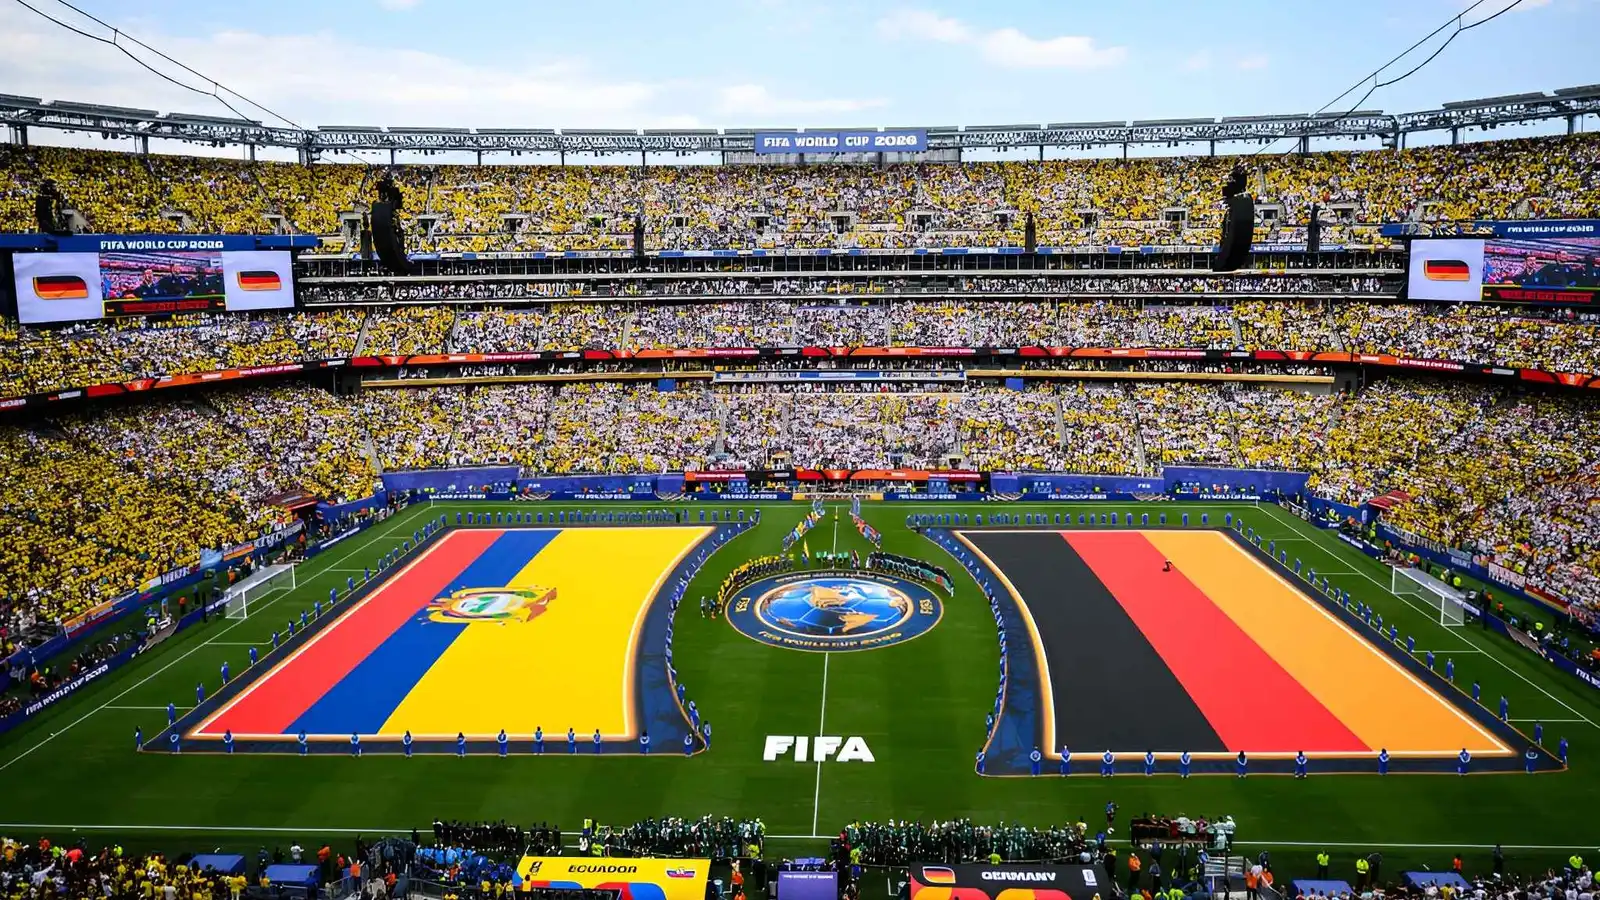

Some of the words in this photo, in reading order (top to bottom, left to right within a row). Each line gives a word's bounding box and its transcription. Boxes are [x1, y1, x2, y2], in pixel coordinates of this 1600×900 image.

[764, 137, 790, 147] FIFA
[795, 136, 839, 147] WORLD
[845, 136, 869, 147] CUP
[100, 240, 125, 250] FIFA
[126, 240, 165, 249] WORLD
[167, 240, 188, 249] CUP
[763, 735, 876, 762] FIFA
[568, 865, 637, 873] ECUADOR
[981, 871, 1056, 881] GERMANY
